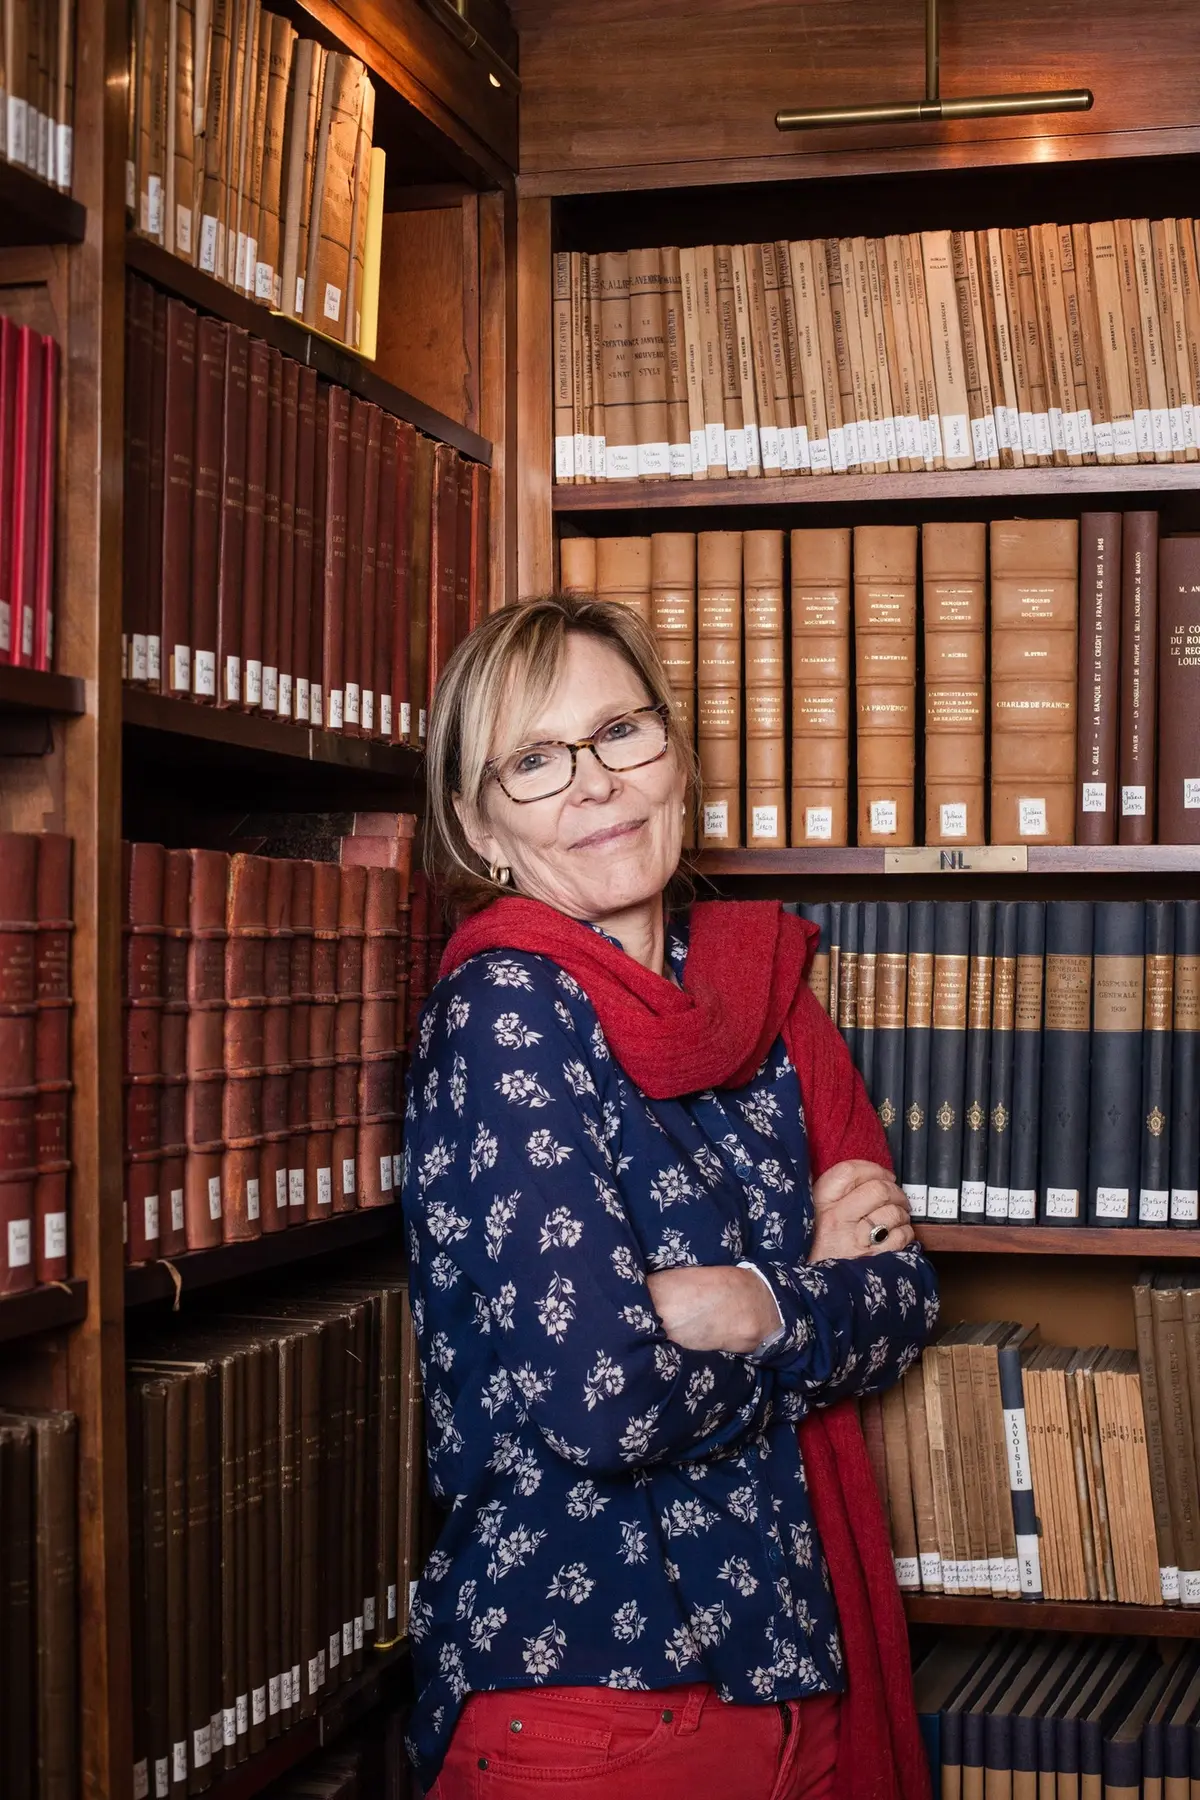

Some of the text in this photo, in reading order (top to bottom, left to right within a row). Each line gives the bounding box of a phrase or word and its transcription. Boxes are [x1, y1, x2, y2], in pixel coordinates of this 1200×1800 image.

[1027, 321, 1038, 345] SWIFT
[1096, 564, 1104, 576] 1815
[1096, 580, 1103, 589] DE
[1095, 593, 1103, 618] FRANCE
[1095, 621, 1103, 630] EN
[1174, 625, 1185, 634] LE
[1170, 636, 1183, 645] DU
[1170, 647, 1181, 655] LE
[1094, 661, 1101, 669] LE
[1094, 673, 1101, 681] ET
[1093, 685, 1101, 712] BANQUE
[1093, 716, 1100, 725] LA
[1091, 746, 1100, 765] GILLE
[940, 850, 971, 870] NL
[1097, 980, 1139, 988] ASSEMBLÉE
[1011, 1414, 1023, 1485] LAVOISIER
